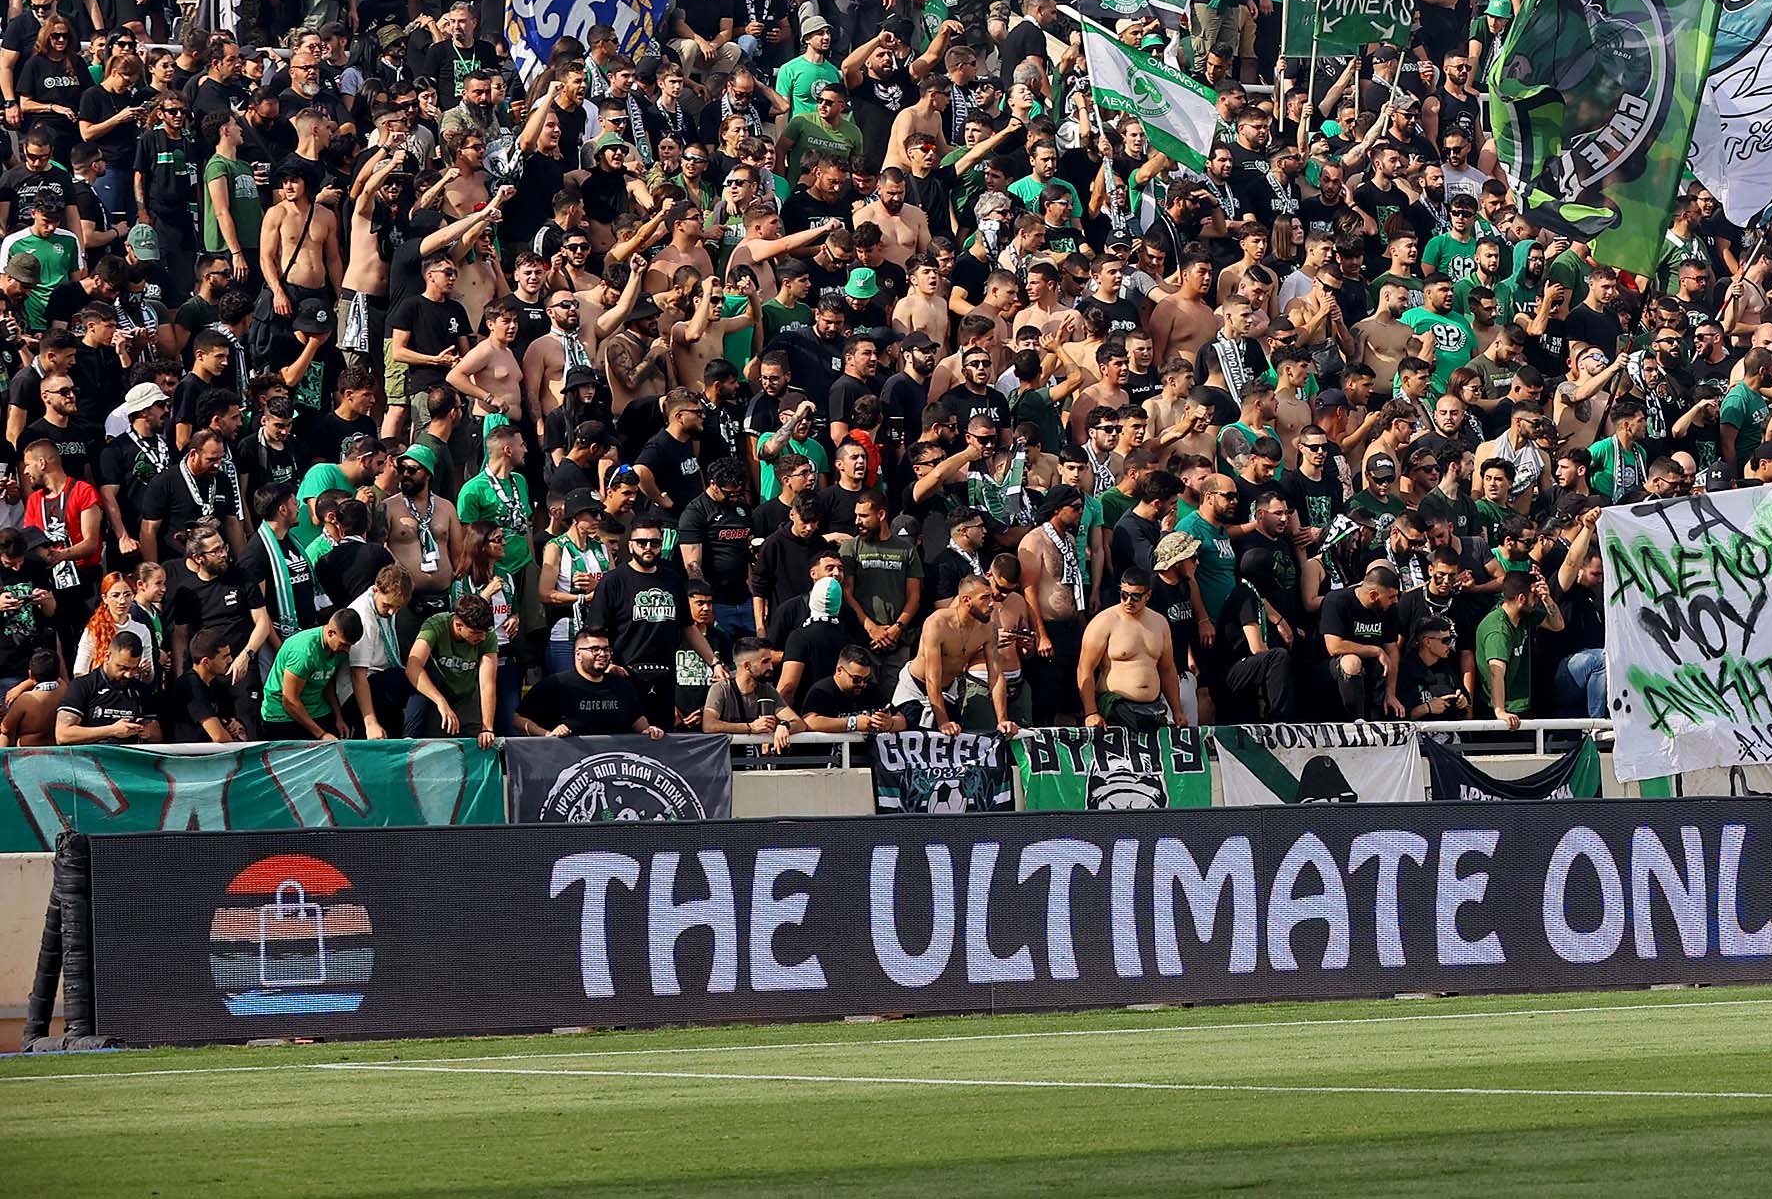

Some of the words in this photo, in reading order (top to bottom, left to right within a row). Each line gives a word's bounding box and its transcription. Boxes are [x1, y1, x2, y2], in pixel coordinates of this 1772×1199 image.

[1433, 324, 1459, 344] 92
[719, 527, 751, 540] FONBE
[1631, 494, 1758, 545] ΤΑ
[1639, 591, 1768, 665] ΜΟΥ
[877, 731, 1000, 771] GREEN
[925, 766, 967, 780] 1932
[549, 848, 829, 998] THE
[870, 829, 1506, 988] ULTIMATE
